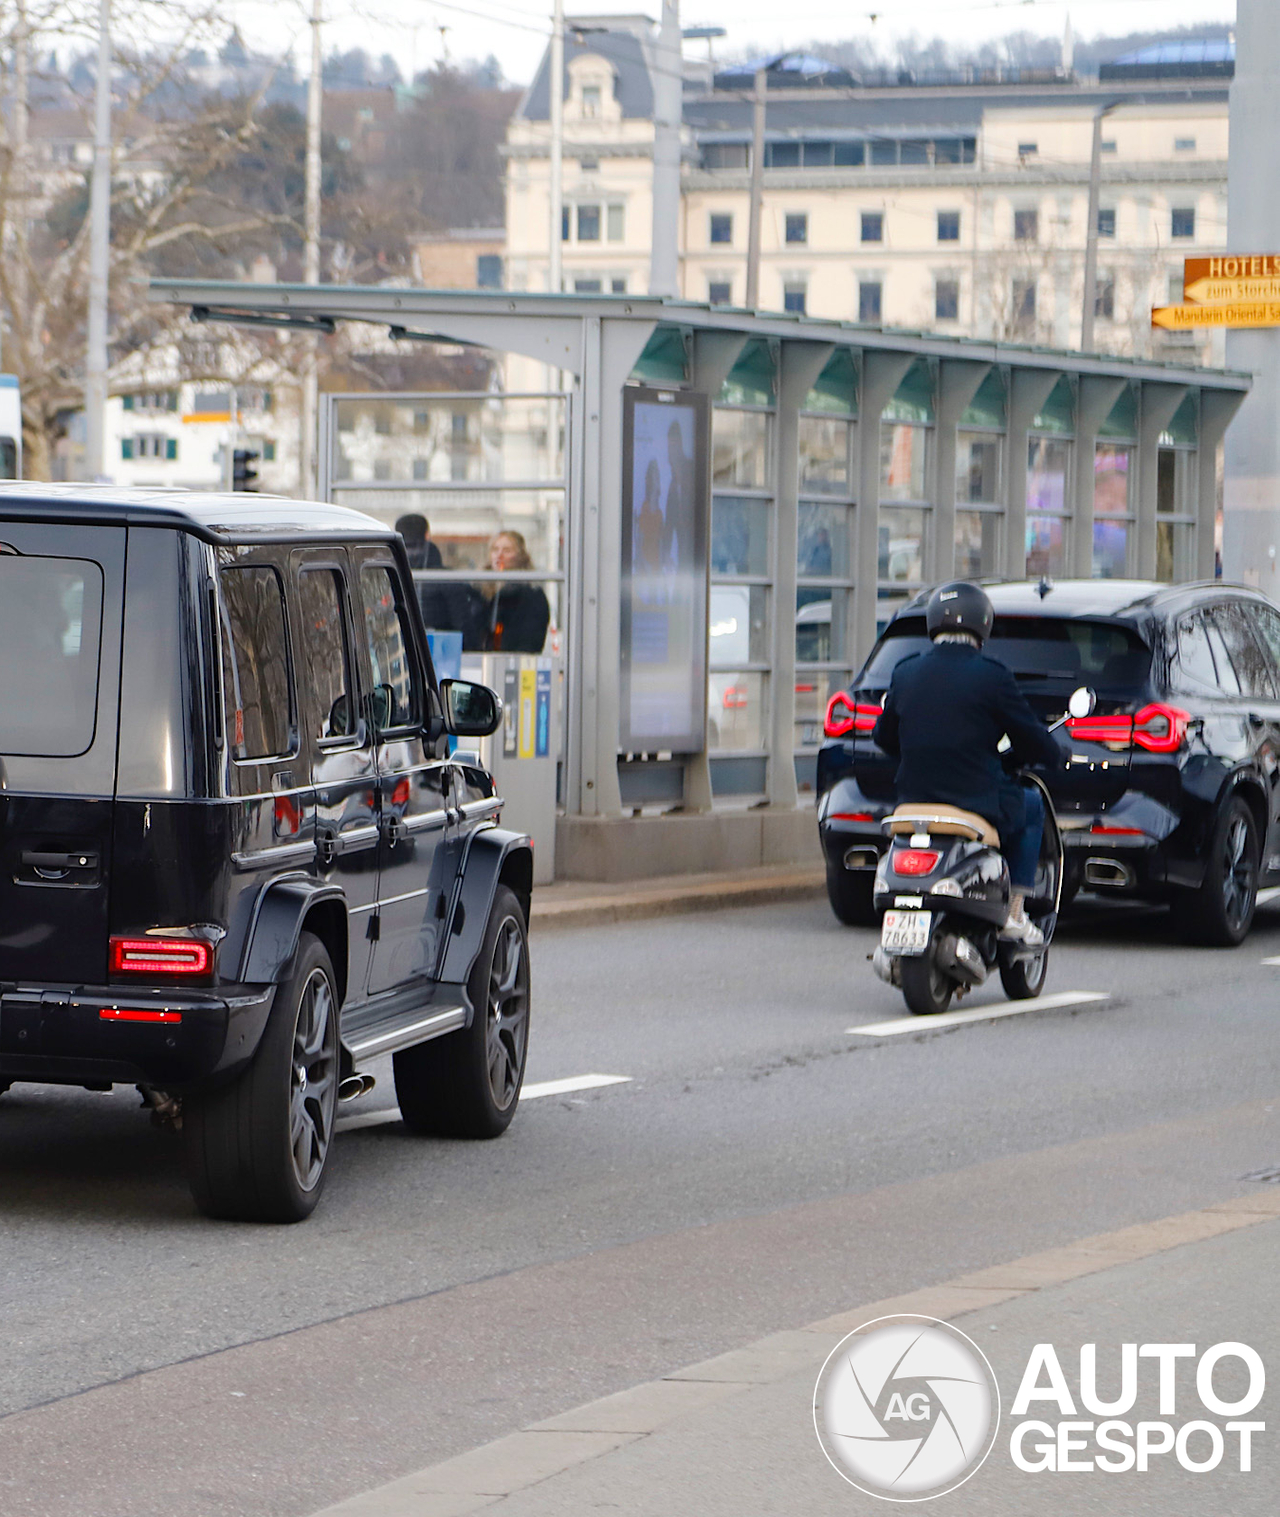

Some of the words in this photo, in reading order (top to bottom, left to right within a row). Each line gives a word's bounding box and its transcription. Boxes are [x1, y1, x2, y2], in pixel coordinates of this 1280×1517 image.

[1209, 254, 1280, 278] HOTELS
[1206, 286, 1232, 299] zum
[1237, 281, 1280, 298] Storch
[1174, 306, 1222, 323] Mandarin
[1226, 304, 1266, 322] Oriental
[898, 914, 917, 928] ZH
[885, 931, 926, 946] 78633
